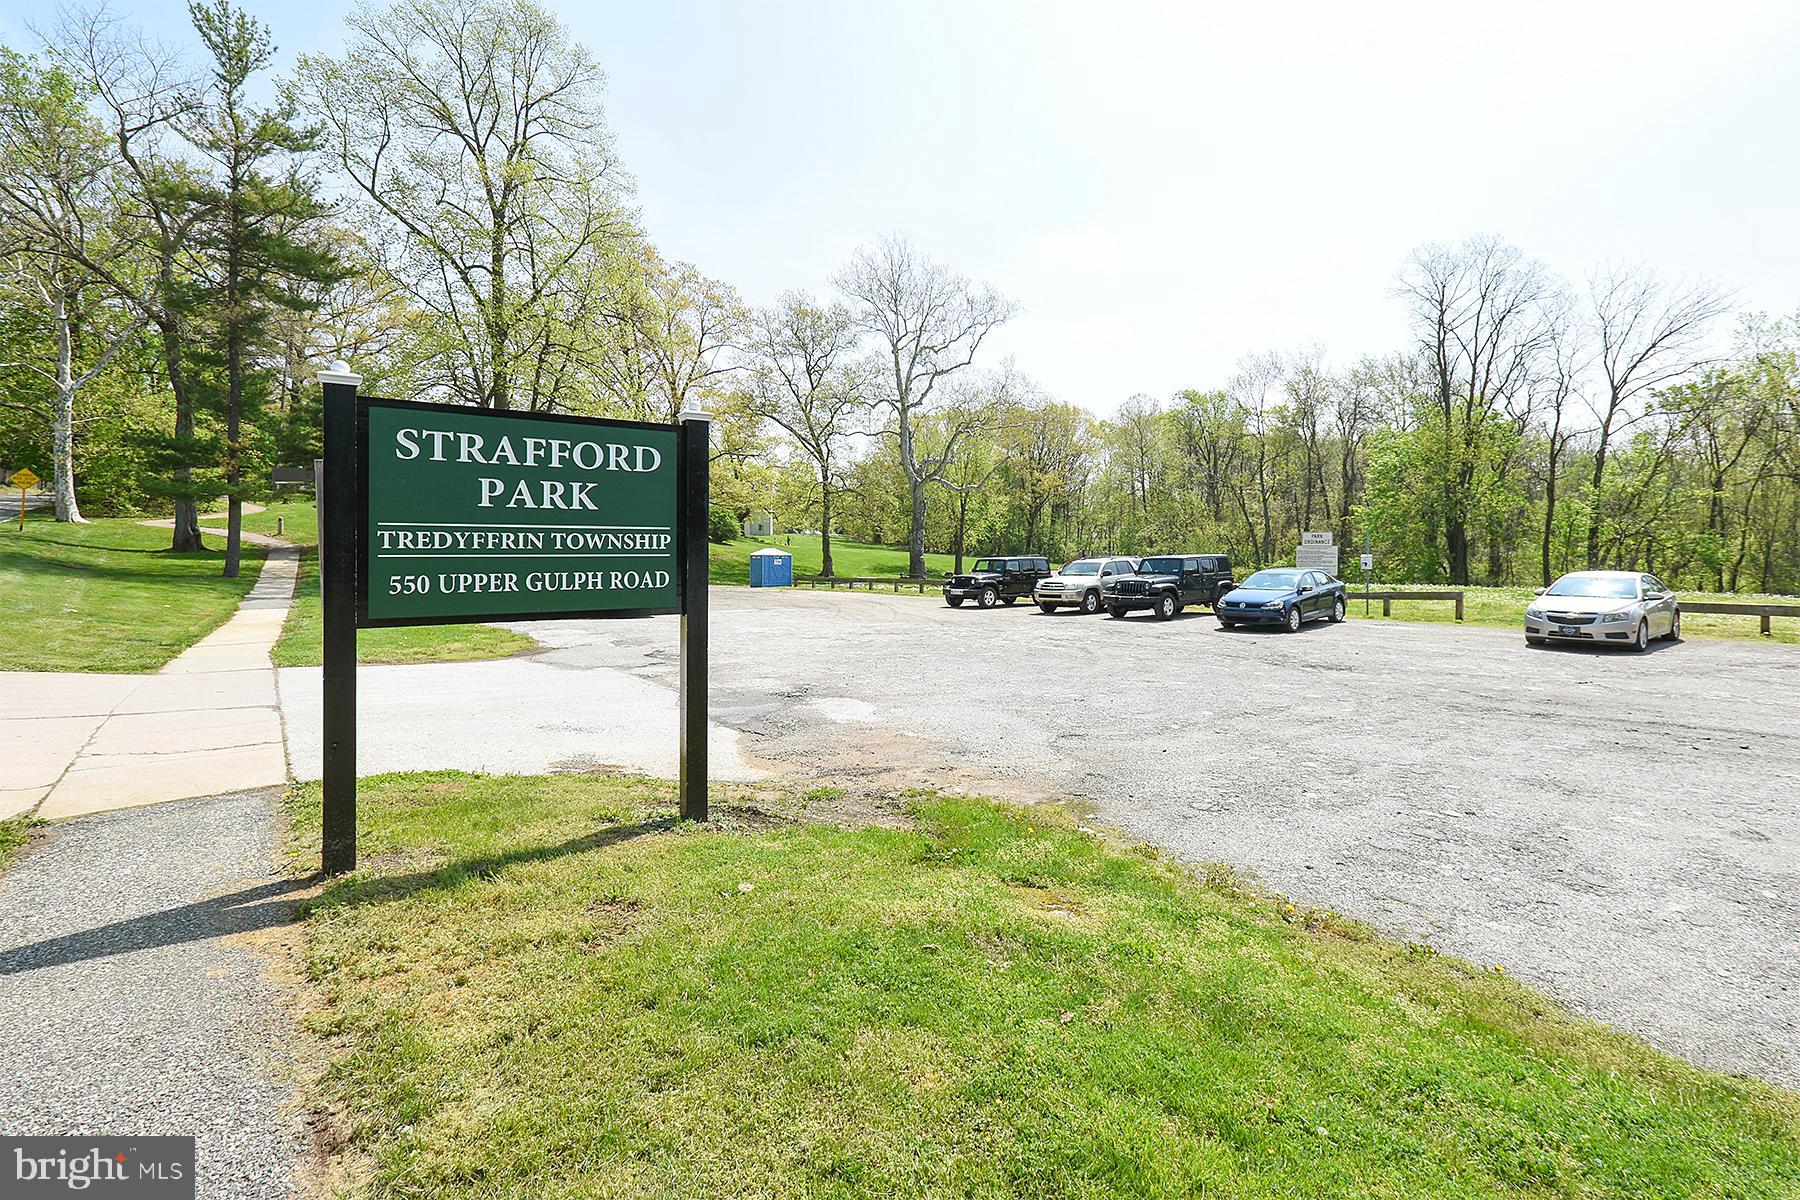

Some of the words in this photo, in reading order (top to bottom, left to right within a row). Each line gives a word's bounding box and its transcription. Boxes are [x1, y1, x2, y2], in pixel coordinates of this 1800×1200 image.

[395, 428, 662, 473] STRAFFORD
[477, 477, 599, 511] PARK
[377, 530, 543, 550] TREDYFFRIN
[550, 532, 672, 550] TOWNSHIP
[388, 574, 430, 595] 550
[437, 573, 520, 594] UPPER
[525, 571, 604, 592] GULPH
[609, 570, 670, 589] ROAD
